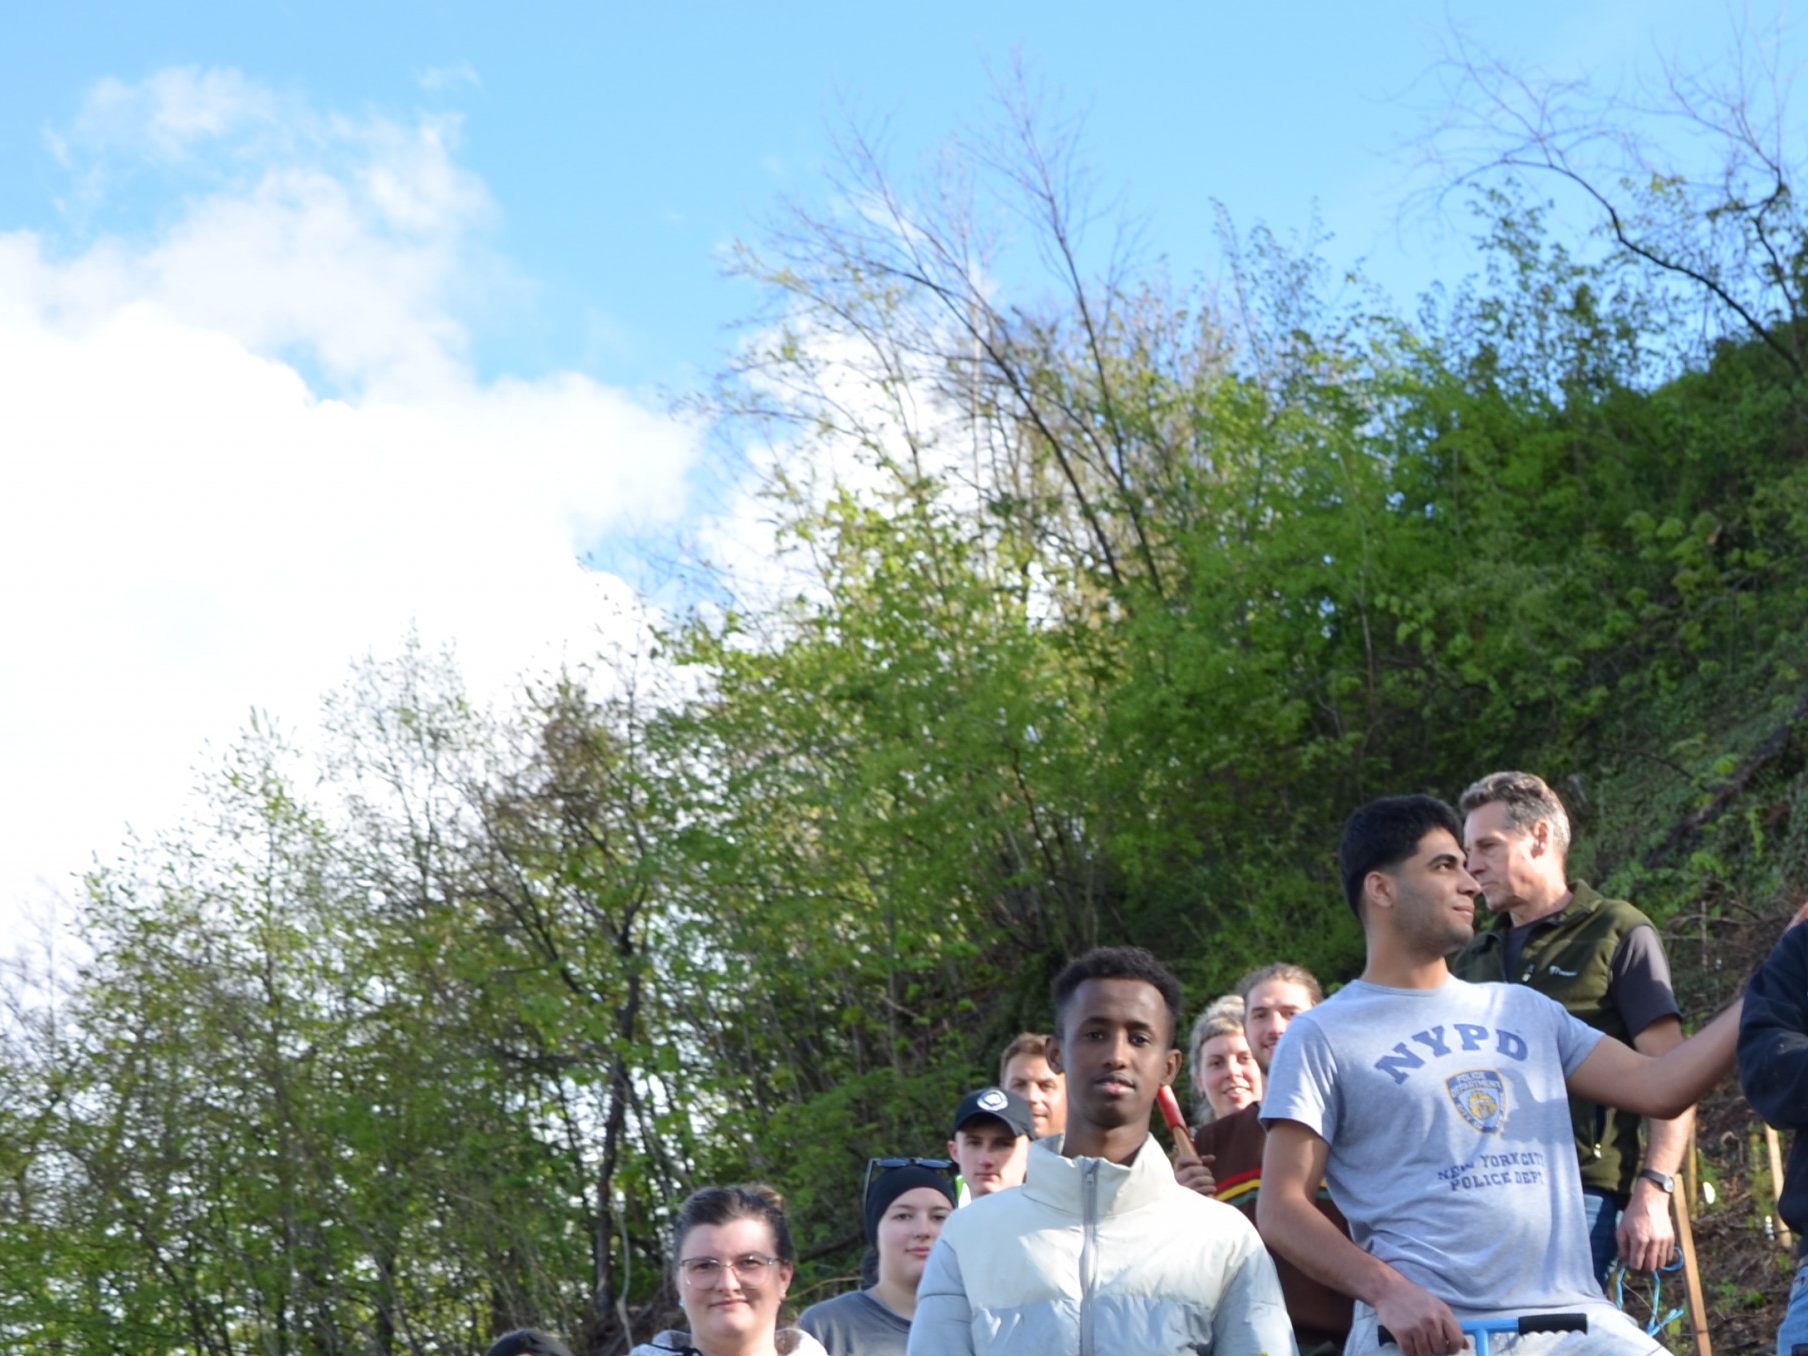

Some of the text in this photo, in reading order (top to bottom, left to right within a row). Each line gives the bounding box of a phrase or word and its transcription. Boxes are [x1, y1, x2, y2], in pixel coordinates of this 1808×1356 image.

[1374, 1023, 1529, 1085] NYPD
[1480, 1151, 1519, 1169] YORK
[1450, 1171, 1512, 1192] POLICE
